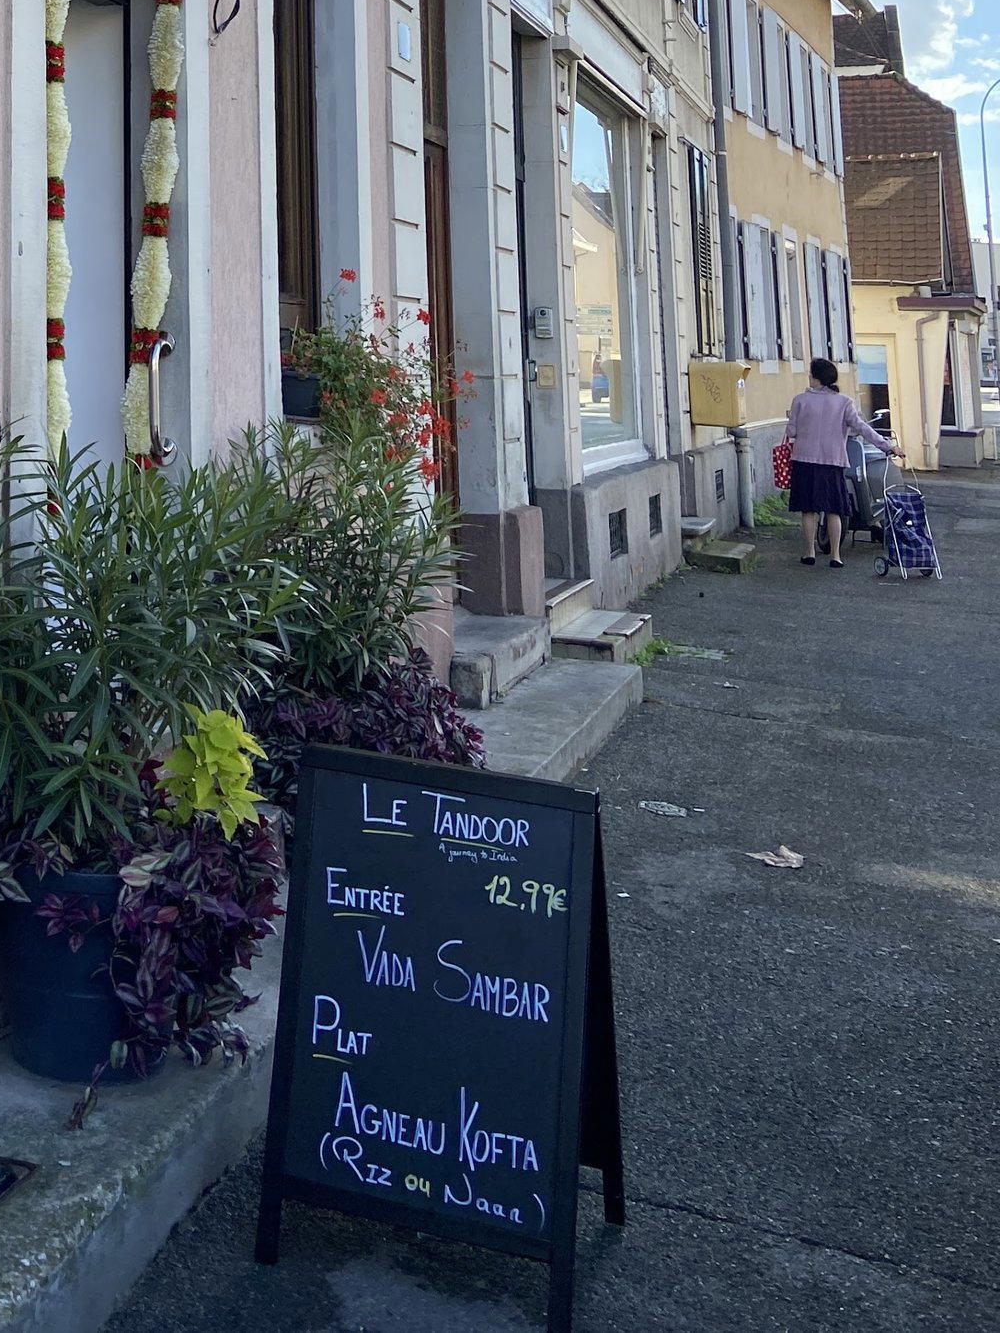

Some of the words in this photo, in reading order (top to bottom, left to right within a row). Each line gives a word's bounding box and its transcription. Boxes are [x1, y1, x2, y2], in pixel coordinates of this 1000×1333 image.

[421, 790, 531, 848] TANDOOR
[438, 842, 446, 854] A
[448, 849, 478, 864] journey
[480, 849, 488, 859] to
[489, 849, 518, 862] India
[326, 866, 405, 917] ENTRÉE
[484, 874, 569, 918] 12.99€
[357, 925, 416, 992] VADA
[433, 939, 550, 1023] SAMBAR
[312, 995, 373, 1055] PLAT
[334, 1071, 446, 1155] AGNEAU
[458, 1086, 539, 1171] KOFTA
